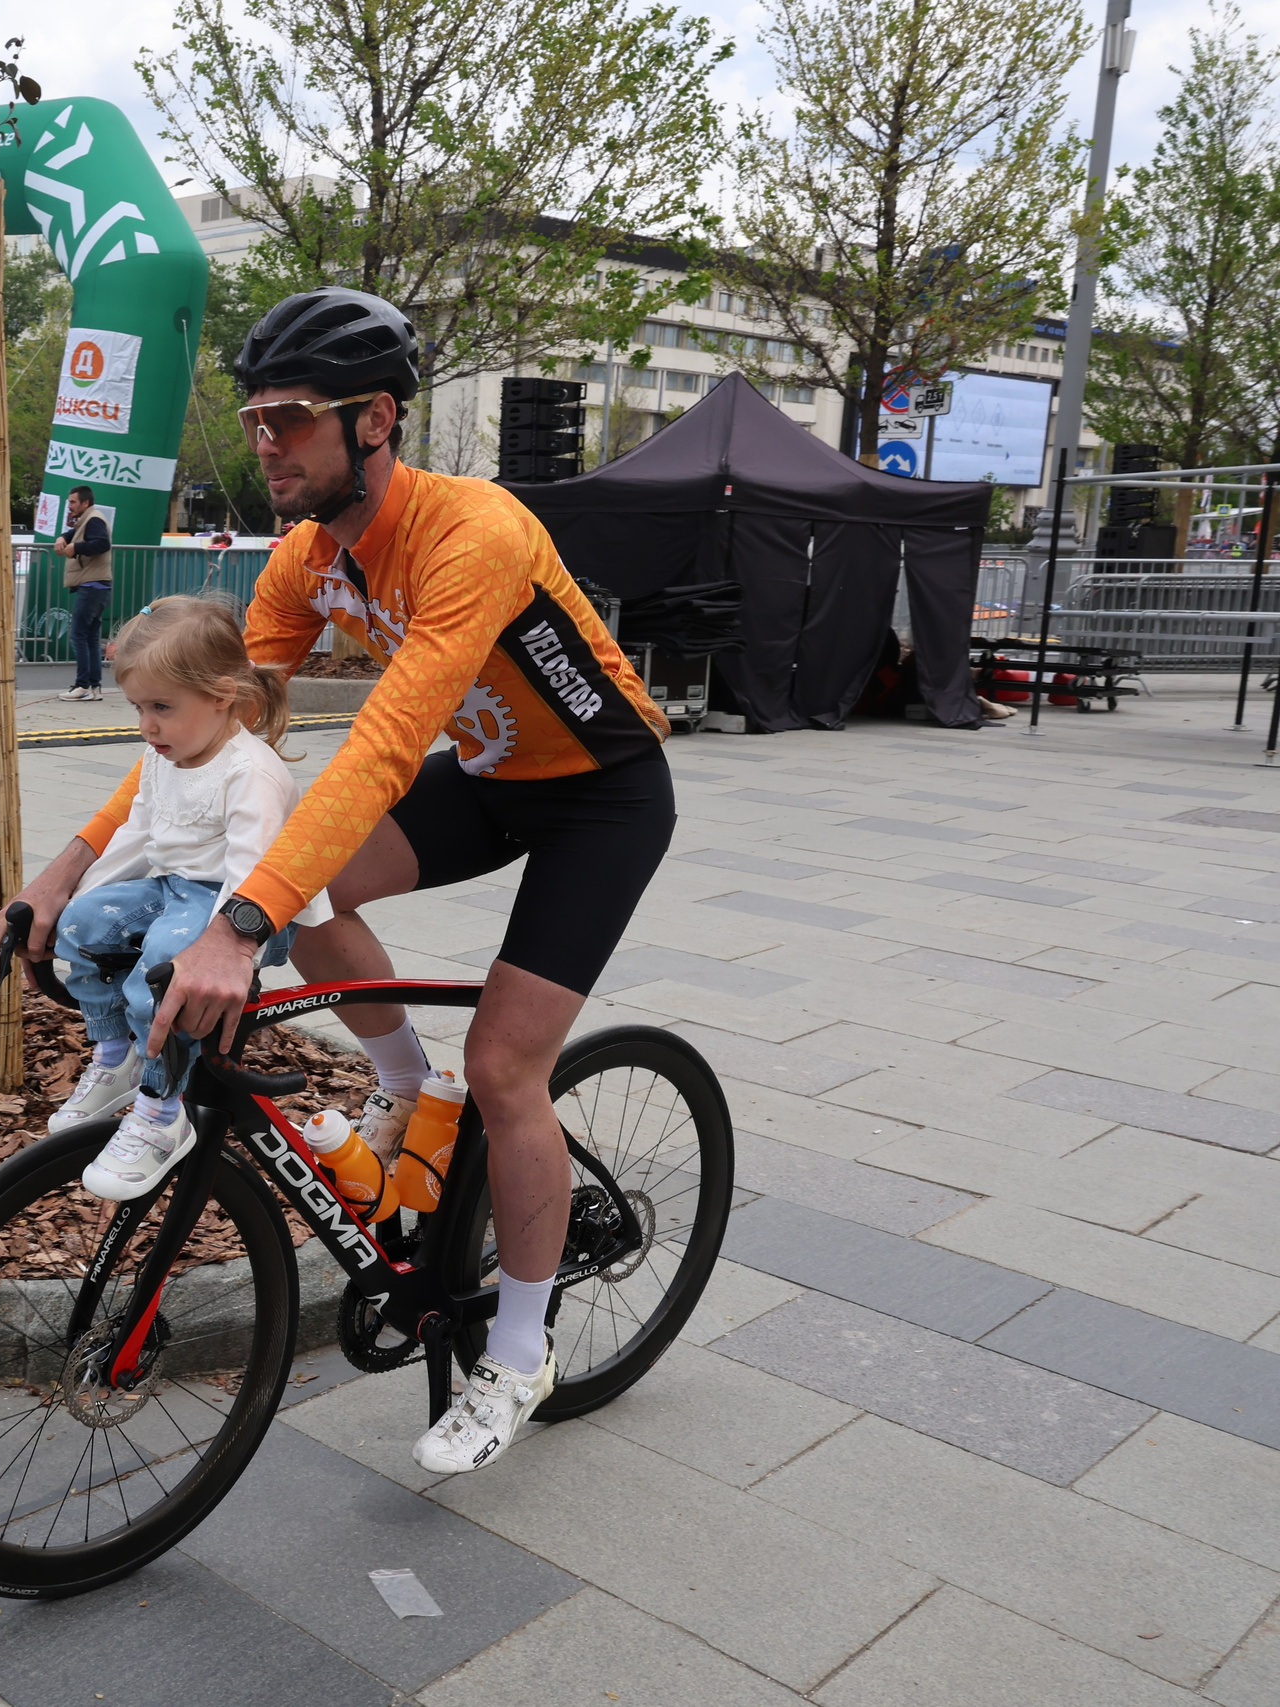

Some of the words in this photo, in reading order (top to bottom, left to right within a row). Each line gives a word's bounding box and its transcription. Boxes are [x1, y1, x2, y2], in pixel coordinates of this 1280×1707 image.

[518, 619, 603, 723] VELOSTAR
[256, 992, 342, 1020] PINARELLO
[370, 1094, 395, 1113] SIDI
[250, 1123, 378, 1270] DOGMA
[90, 1206, 131, 1283] PINARELLO
[553, 1265, 599, 1286] NARELLO
[472, 1363, 499, 1385] SIDI
[472, 1434, 500, 1469] SIDI
